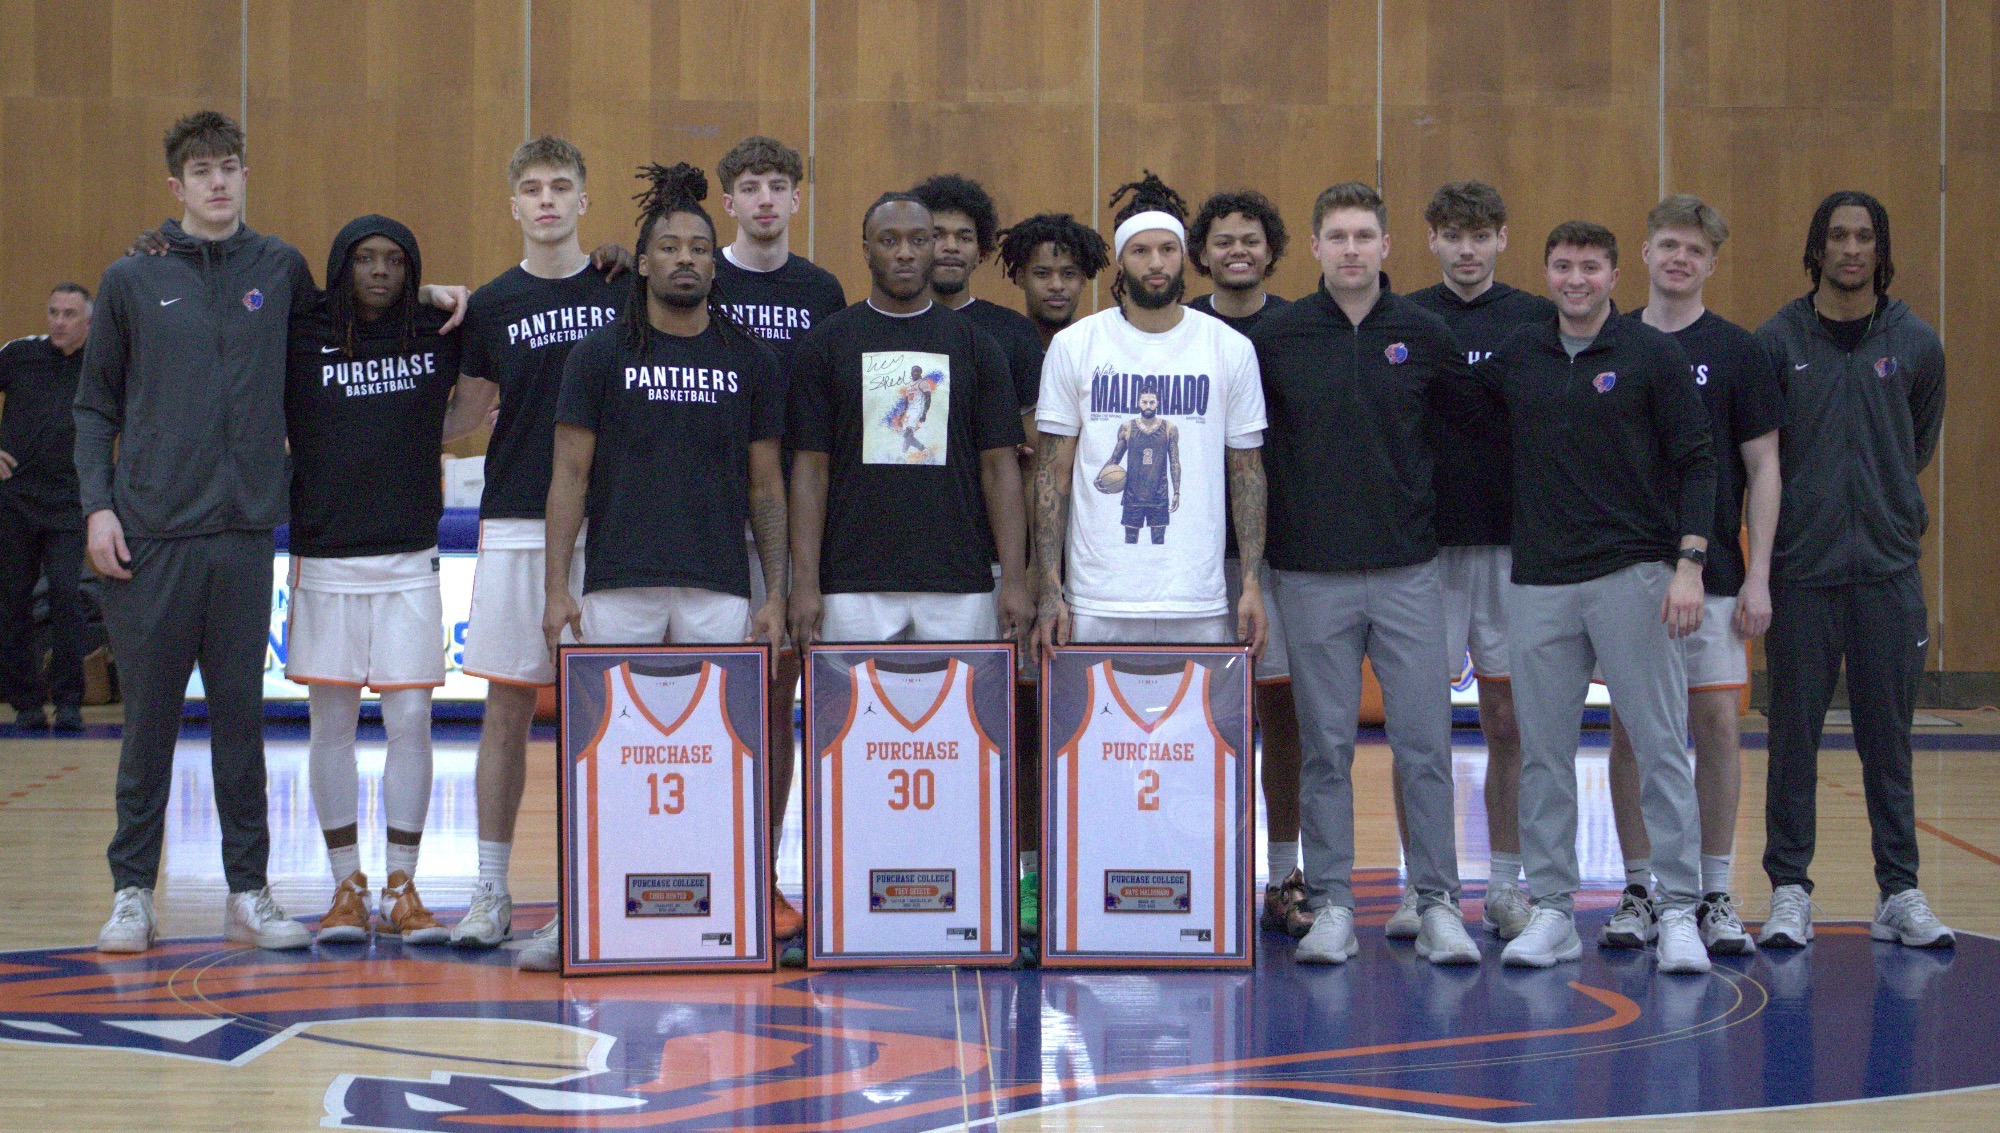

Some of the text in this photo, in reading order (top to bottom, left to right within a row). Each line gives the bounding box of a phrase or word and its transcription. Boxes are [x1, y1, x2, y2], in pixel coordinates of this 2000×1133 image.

[507, 306, 616, 345] PANTHERS
[322, 352, 436, 387] PURCHASE
[1092, 362, 1117, 380] Nate
[345, 377, 417, 398] BASKETBALL
[624, 366, 739, 394] PANTHERS
[648, 388, 718, 404] BASKETBALL
[1142, 448, 1153, 465] 2
[621, 745, 713, 765] PURCHASE
[866, 741, 959, 761] PURCHASE
[1102, 742, 1194, 762] PURCHASE
[647, 773, 685, 815] 13
[888, 769, 935, 811] 30
[1138, 769, 1160, 811] 2
[632, 878, 705, 888] PURCHASE COLLEGE
[876, 874, 950, 883] PURCHASE COLLEGE
[1111, 875, 1185, 884] PURCHASE COLLEGE
